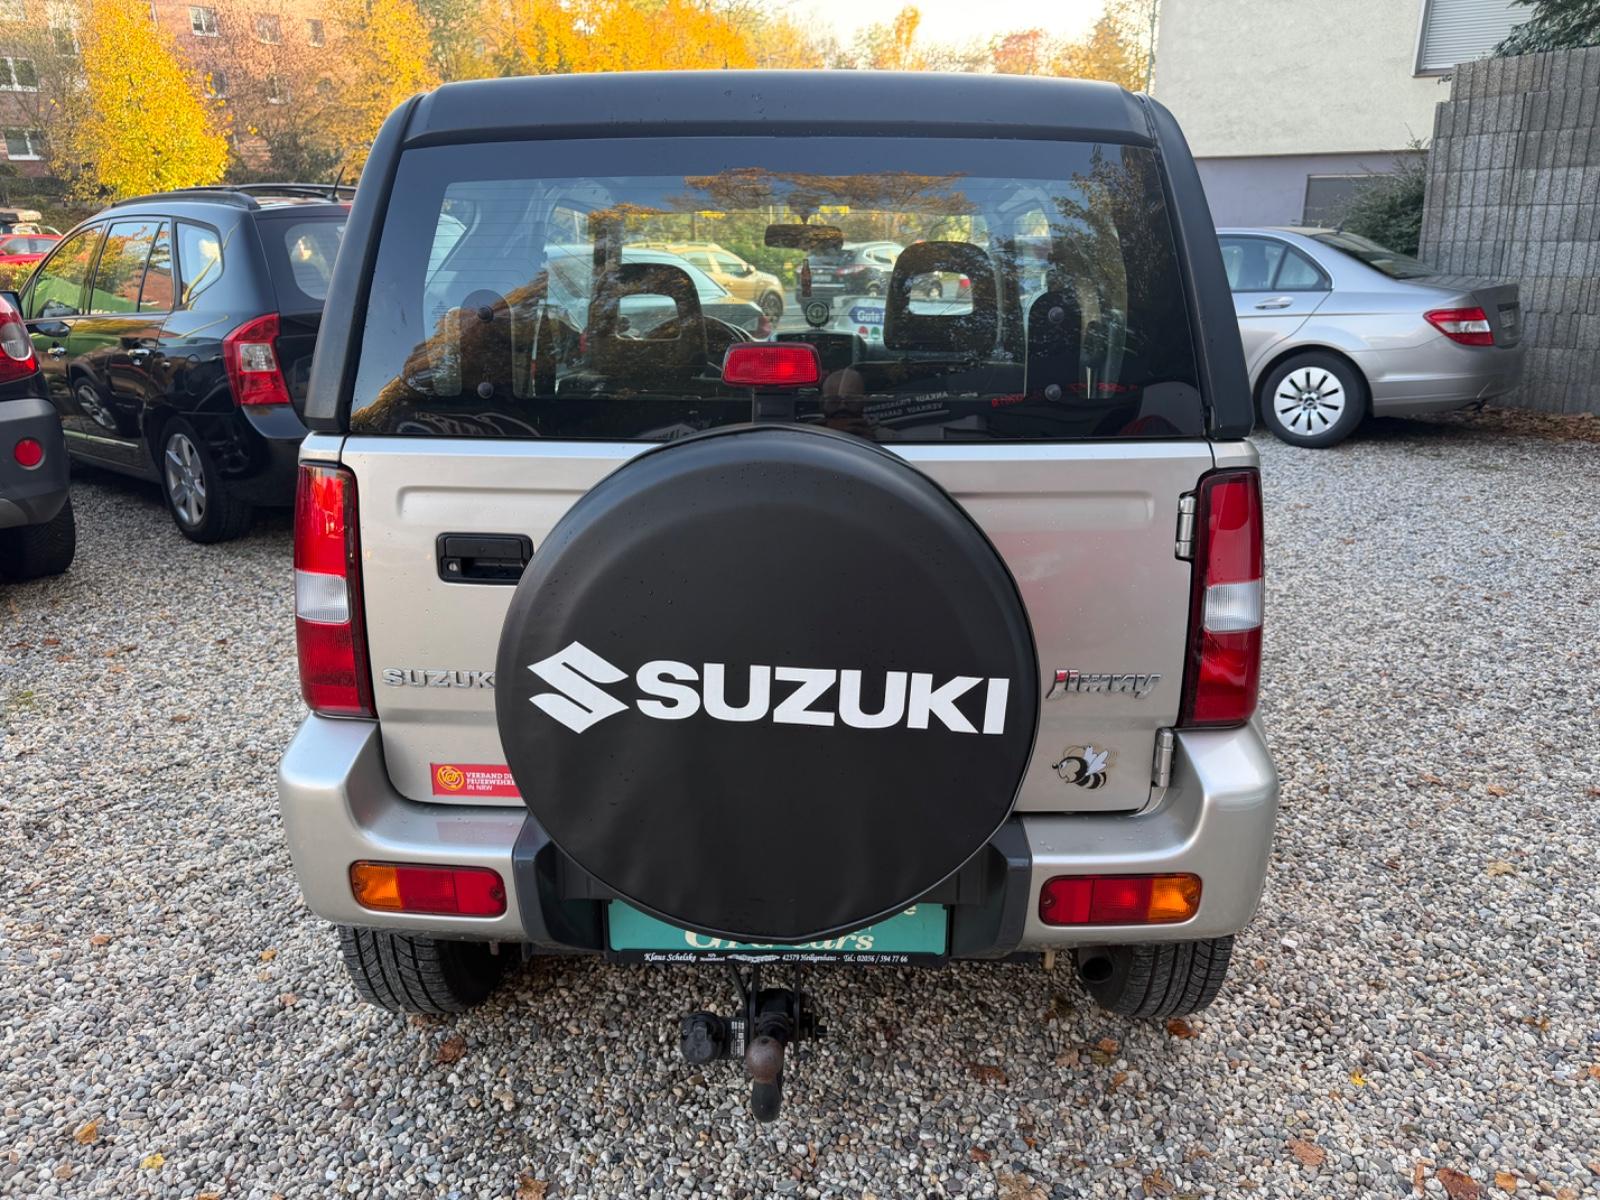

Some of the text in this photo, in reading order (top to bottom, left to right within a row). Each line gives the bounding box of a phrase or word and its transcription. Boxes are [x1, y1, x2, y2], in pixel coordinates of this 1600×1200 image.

[382, 667, 497, 689] SUZUK
[635, 659, 1010, 735] SUZUKI
[466, 771, 503, 779] VERBAND
[644, 952, 667, 962] Klaus
